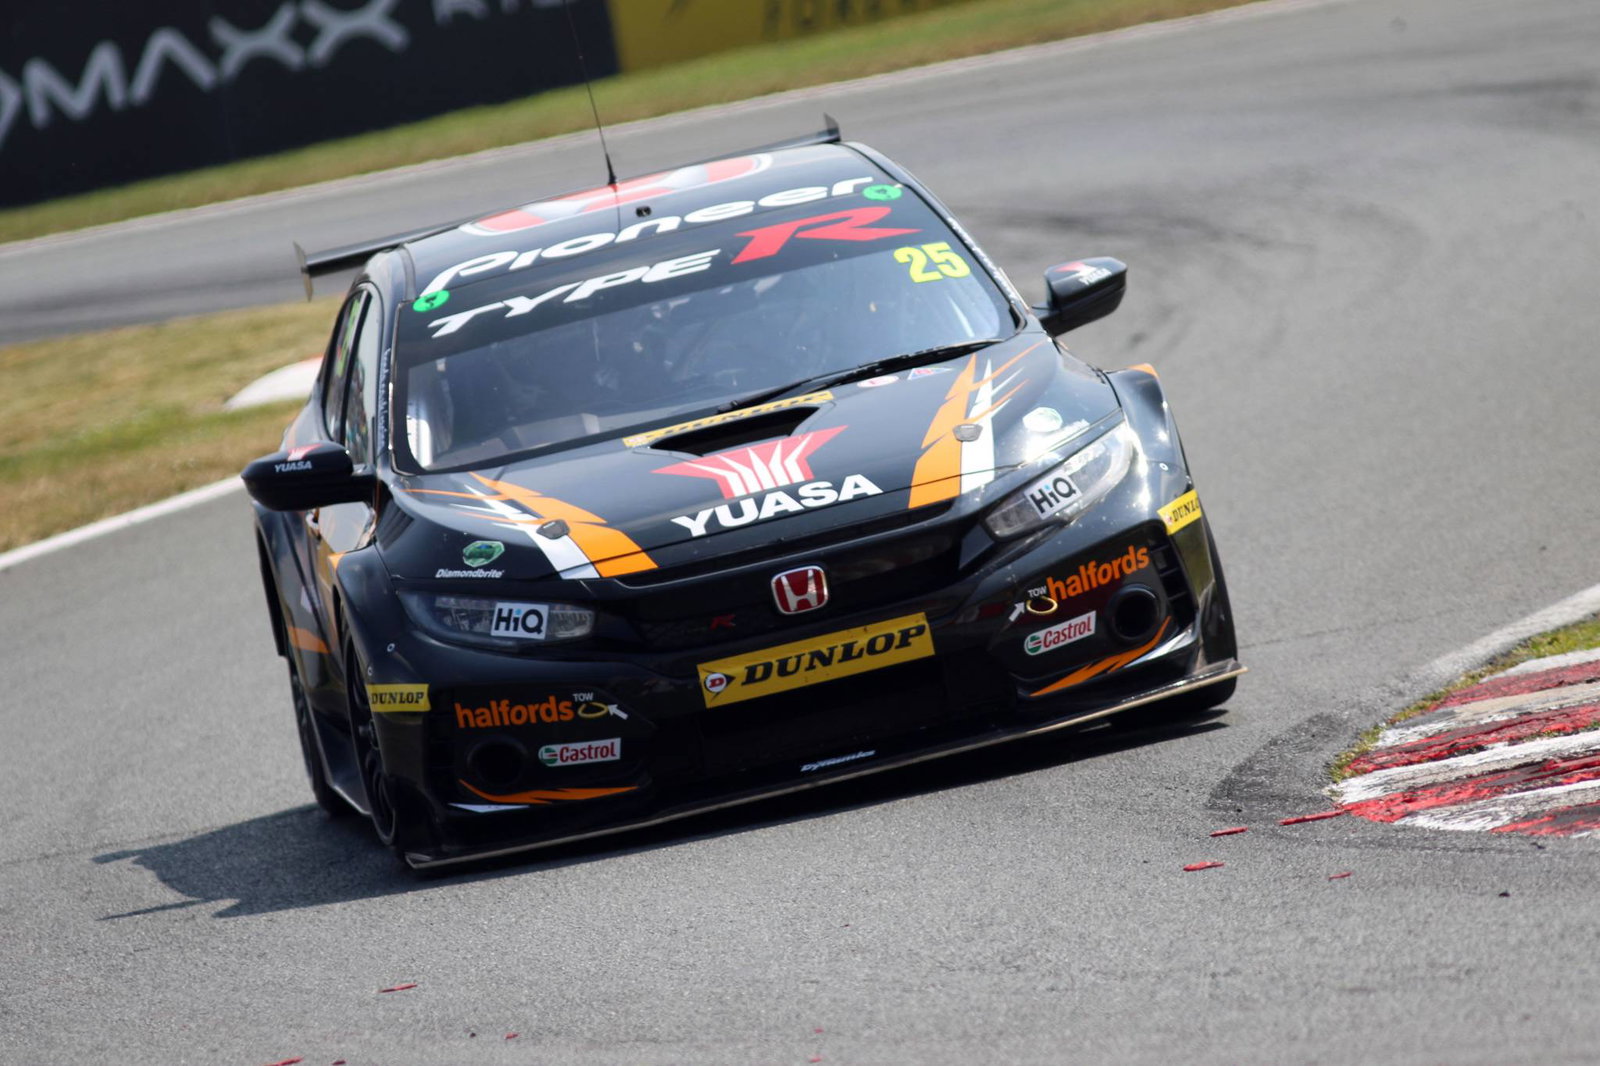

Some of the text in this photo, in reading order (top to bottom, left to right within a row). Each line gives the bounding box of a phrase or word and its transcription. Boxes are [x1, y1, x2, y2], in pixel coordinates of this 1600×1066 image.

[420, 176, 874, 298] pioneer
[427, 248, 721, 338] TYPE
[731, 206, 924, 264] R
[893, 241, 970, 283] 25
[274, 460, 312, 473] YUASA
[670, 473, 884, 537] YUASA
[1029, 476, 1077, 514] HiQ
[435, 568, 503, 578] Diamondbrite
[1047, 545, 1149, 600] halfords
[1028, 586, 1047, 597] TOW
[494, 607, 544, 635] HiQ
[1043, 618, 1092, 648] Castrol
[741, 624, 926, 686] DUNLOP
[371, 691, 424, 705] DUNLOP
[454, 695, 575, 728] halfords
[573, 692, 593, 702] TOW
[559, 741, 617, 764] Castrol
